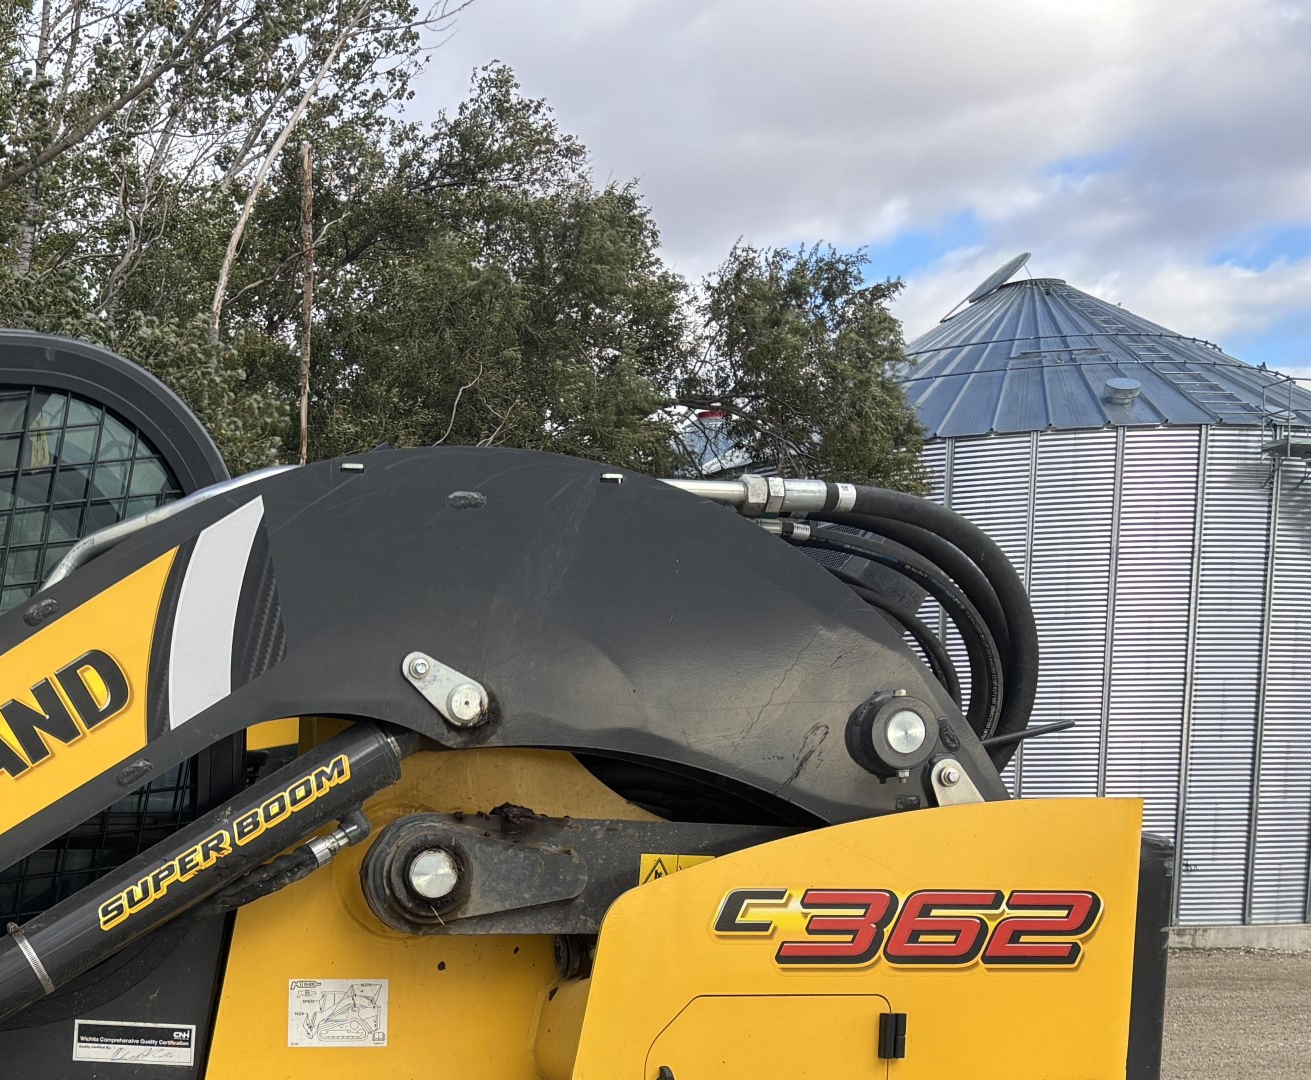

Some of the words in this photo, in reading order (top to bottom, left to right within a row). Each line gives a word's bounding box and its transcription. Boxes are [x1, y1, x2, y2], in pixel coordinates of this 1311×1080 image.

[98, 829, 232, 931] SUPER
[233, 754, 351, 846] BOOM
[99, 1036, 139, 1045] Comprehensive
[140, 1038, 158, 1046] Quality
